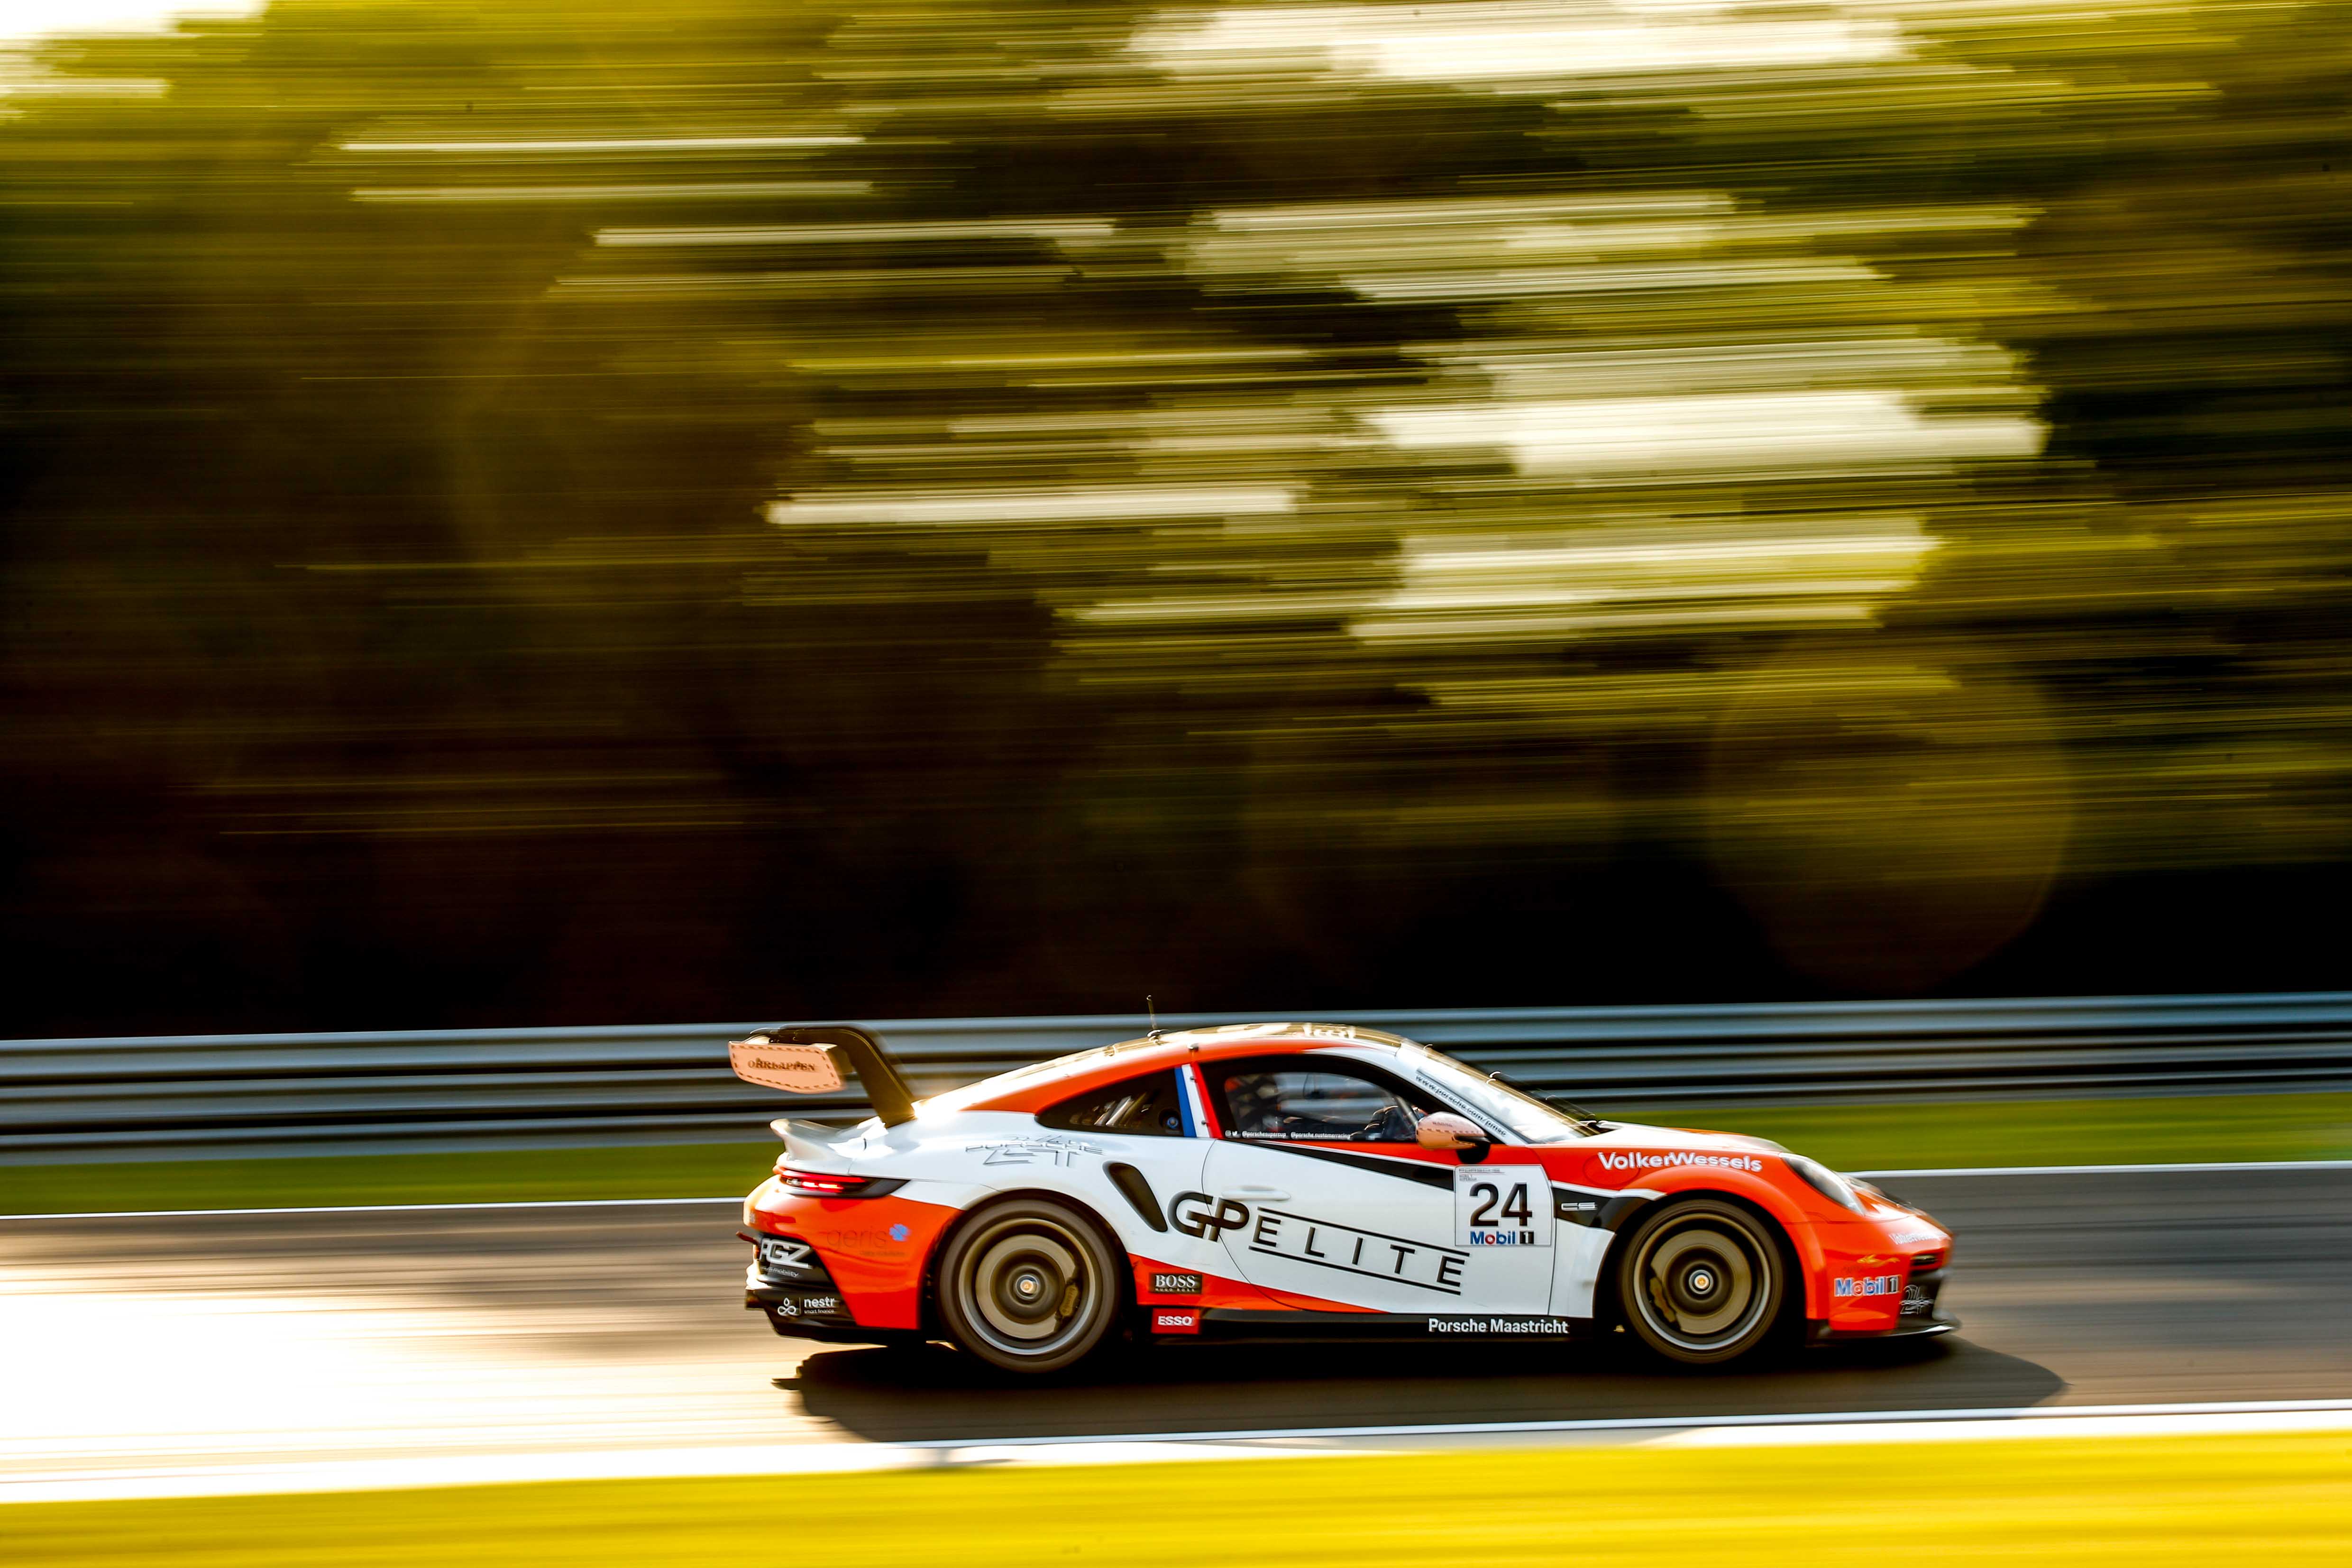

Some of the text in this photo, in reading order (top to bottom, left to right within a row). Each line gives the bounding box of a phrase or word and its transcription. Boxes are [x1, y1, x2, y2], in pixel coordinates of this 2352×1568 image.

[1597, 1151, 1763, 1172] VolkerWessels
[1470, 1182, 1533, 1226] 24
[1470, 1231, 1515, 1244] Mobil
[1252, 1215, 1466, 1287] ELITE
[1155, 1275, 1195, 1288] BOSS
[1834, 1276, 1885, 1297] Mobil
[804, 1297, 836, 1308] nestr
[1158, 1316, 1194, 1326] ESSO
[1428, 1318, 1569, 1333] Porsche Maastricht
